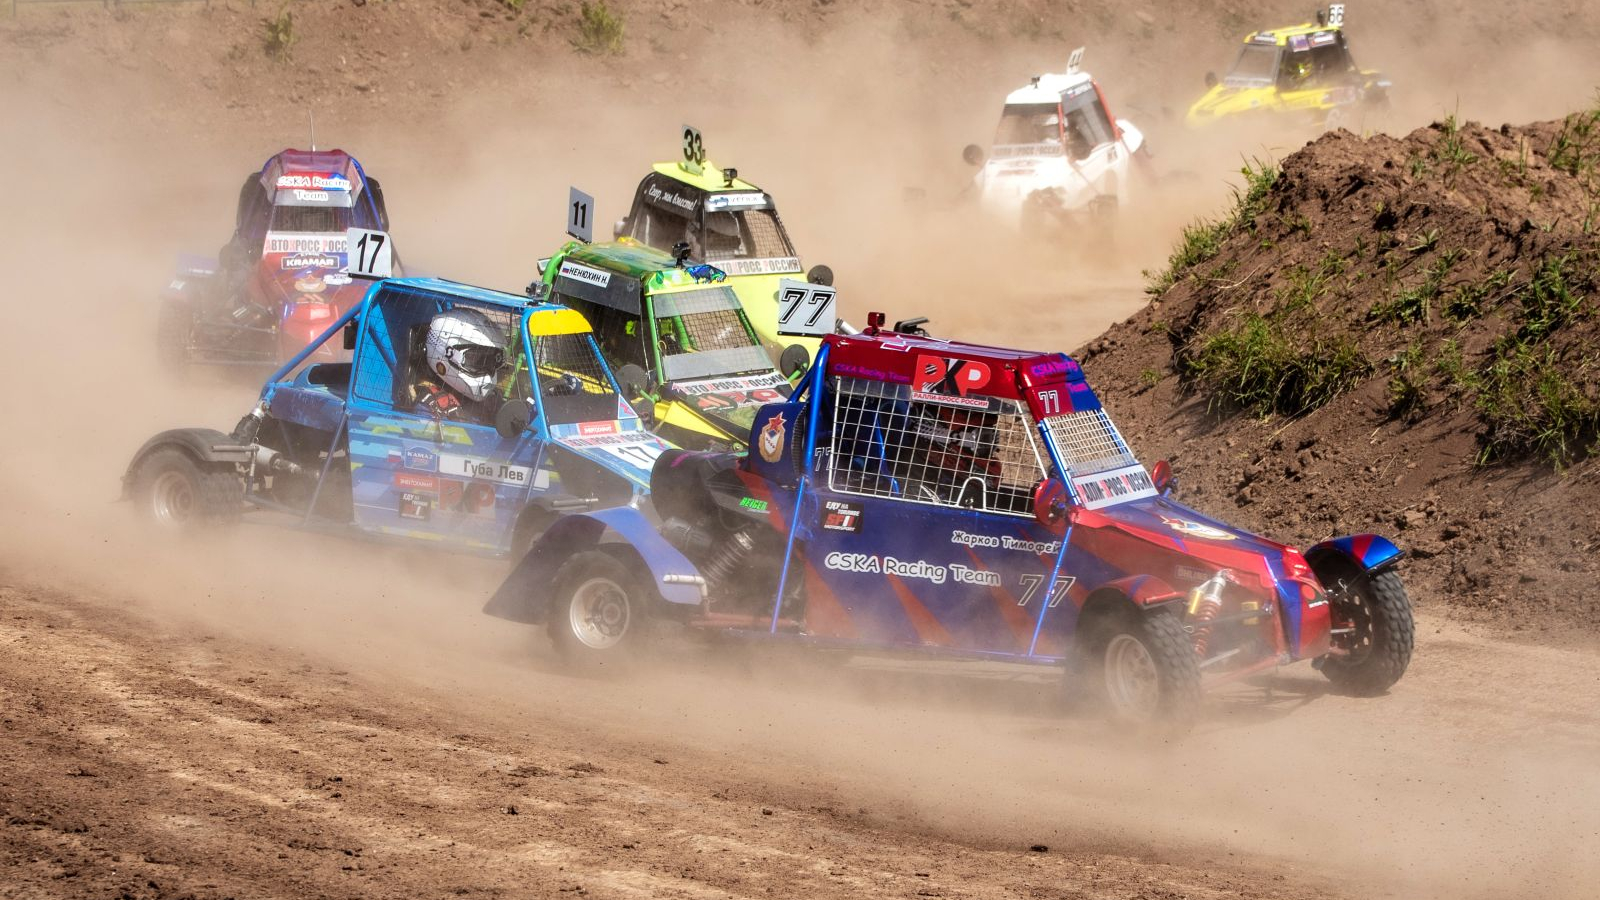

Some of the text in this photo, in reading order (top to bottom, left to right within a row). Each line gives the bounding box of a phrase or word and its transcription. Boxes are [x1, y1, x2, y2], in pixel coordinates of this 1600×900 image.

[683, 129, 702, 166] 33
[313, 176, 352, 189] Racing
[296, 190, 328, 201] Team
[573, 201, 587, 229] 11
[322, 239, 348, 252] РОСС
[357, 233, 385, 273] 17
[286, 258, 335, 267] KRAMAR
[714, 262, 762, 274] ТОКРОСС
[569, 267, 600, 282] НЕНЮХИН
[779, 288, 835, 327] 77
[741, 373, 786, 388] РОССИИ
[913, 393, 989, 407] РАЛЛИ-КРОСС РОССИИ
[1038, 389, 1060, 414] 77
[617, 446, 658, 464] 17
[814, 446, 833, 472] 77
[463, 459, 524, 481] Губа Лев
[1120, 471, 1154, 494] РОССИИ
[826, 501, 841, 510] ЕДУ
[952, 530, 1062, 554] Жарков Тимофей
[825, 552, 1001, 587] CSKA Racing Team
[1017, 573, 1077, 608] 77
